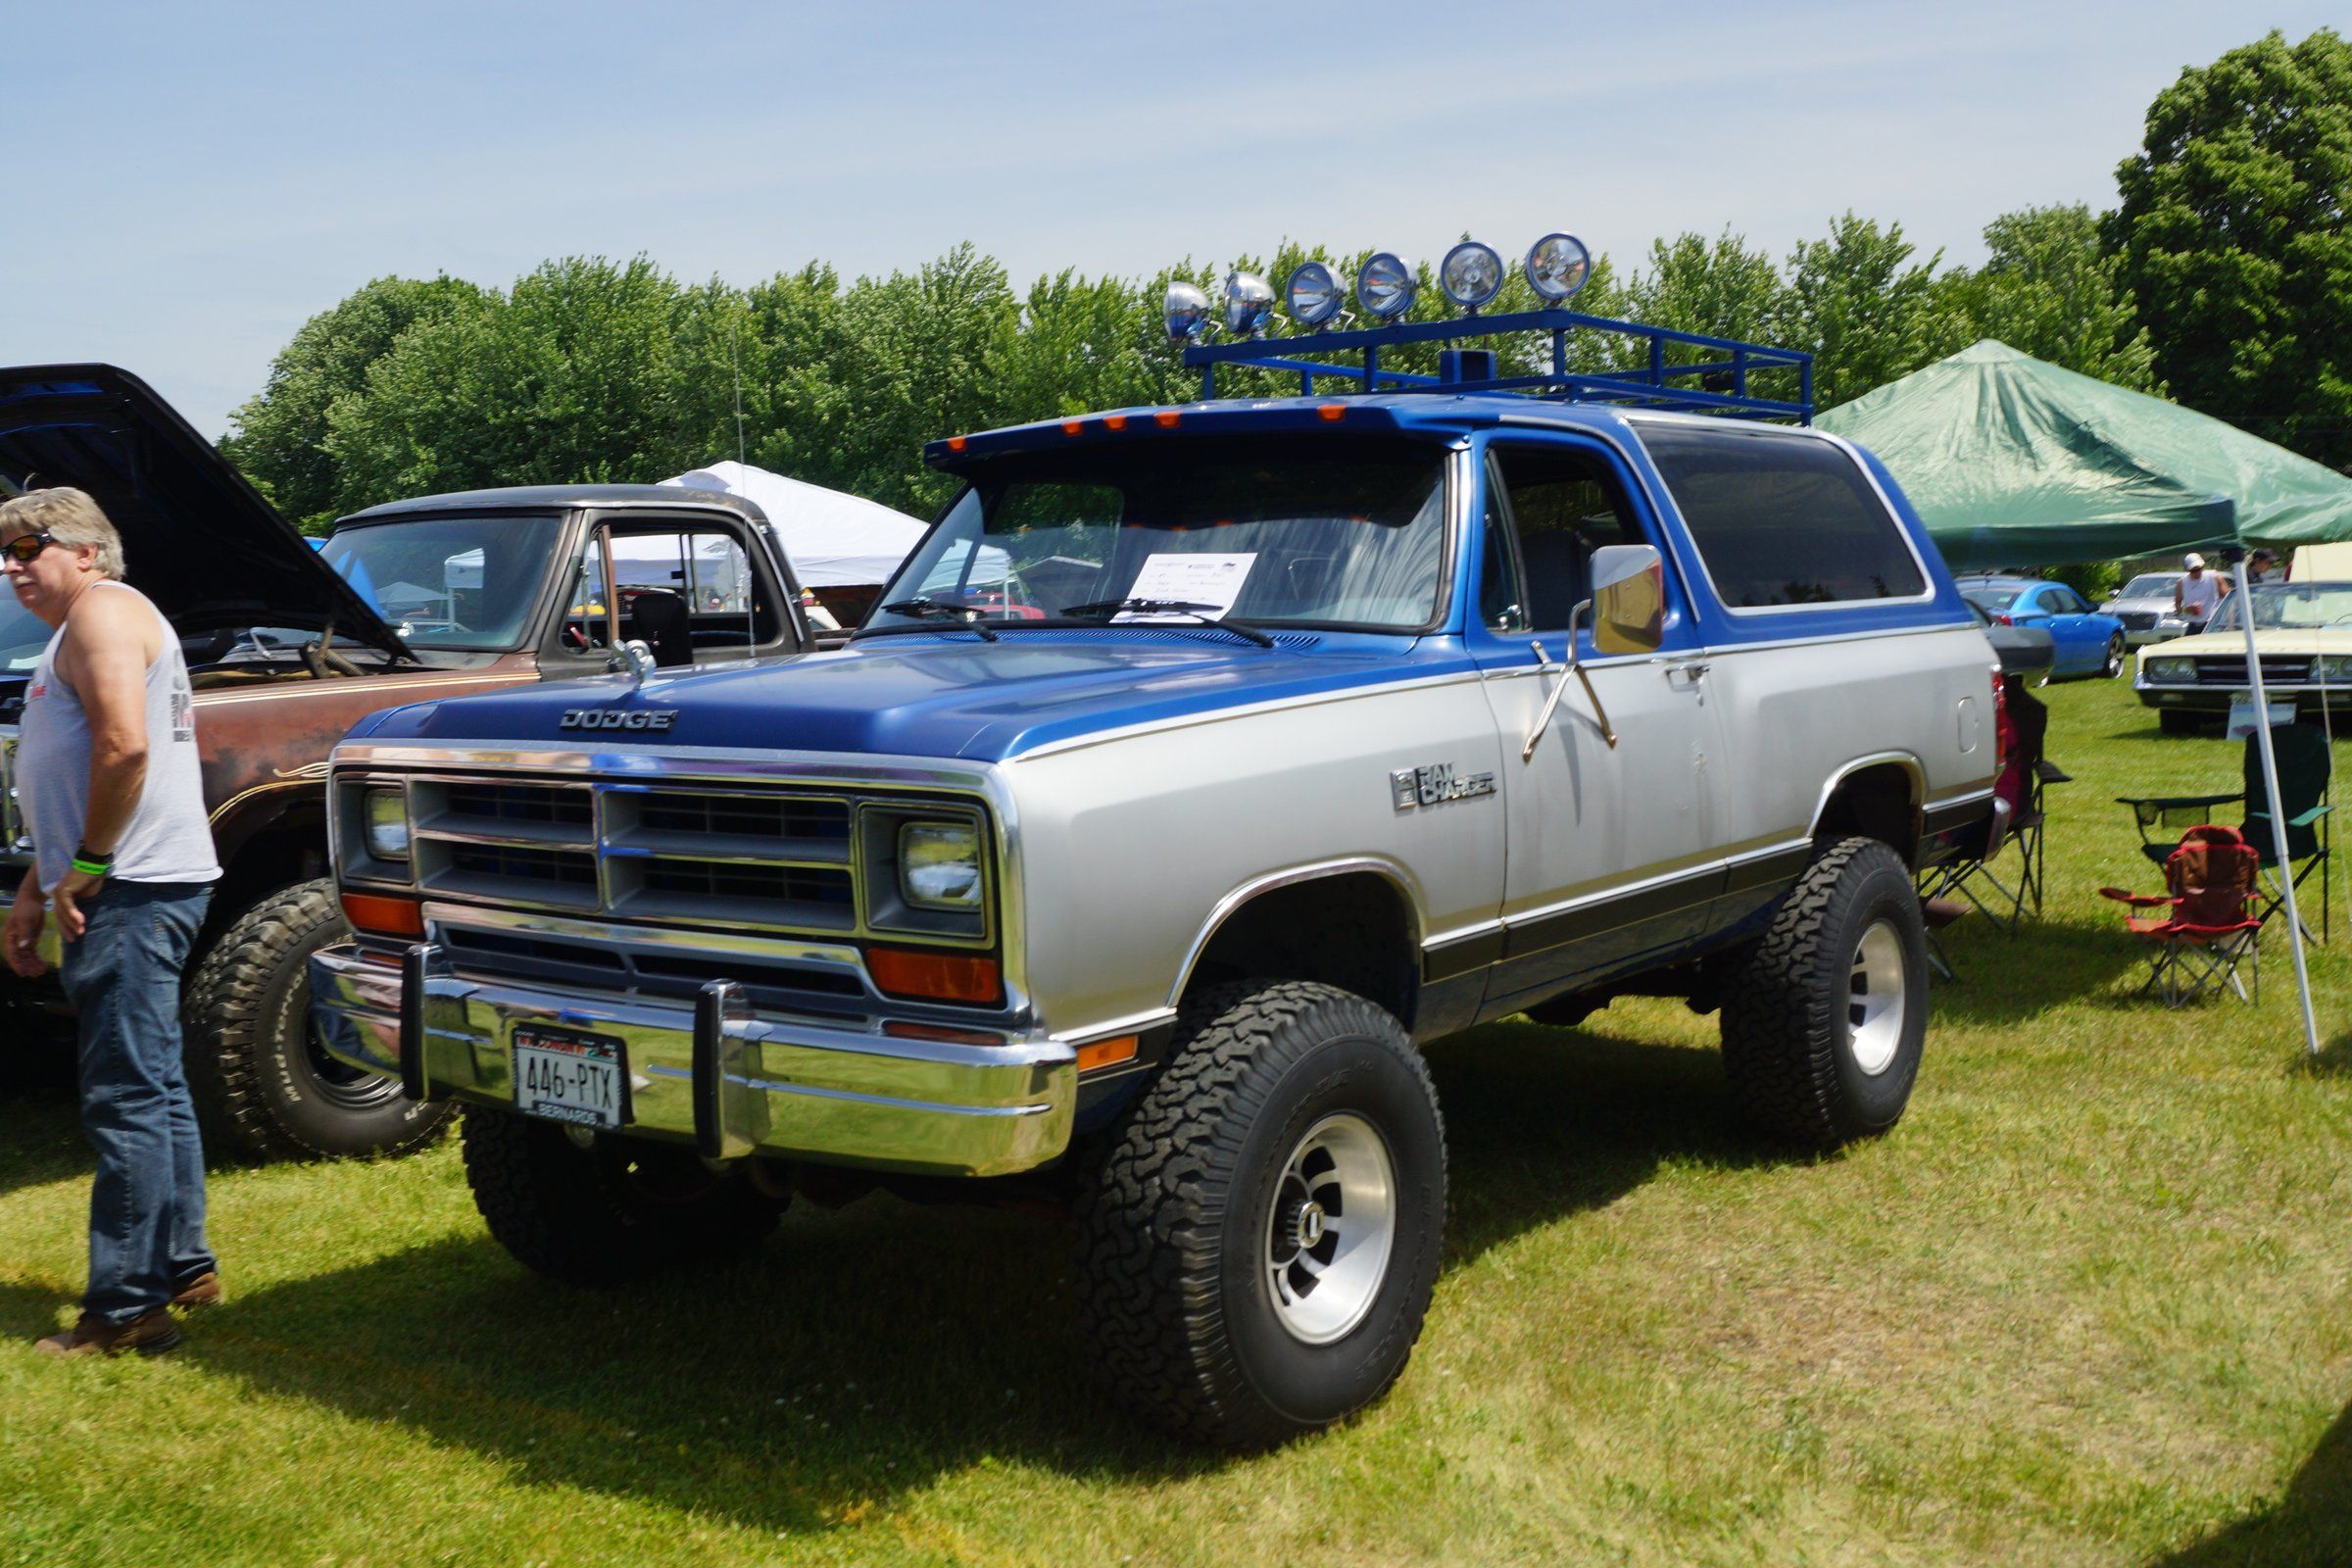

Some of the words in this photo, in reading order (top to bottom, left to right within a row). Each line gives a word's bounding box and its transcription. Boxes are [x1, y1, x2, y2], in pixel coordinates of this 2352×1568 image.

[560, 709, 679, 730] DODGE
[1416, 762, 1453, 786] RAM
[527, 1055, 612, 1109] 446-PTX
